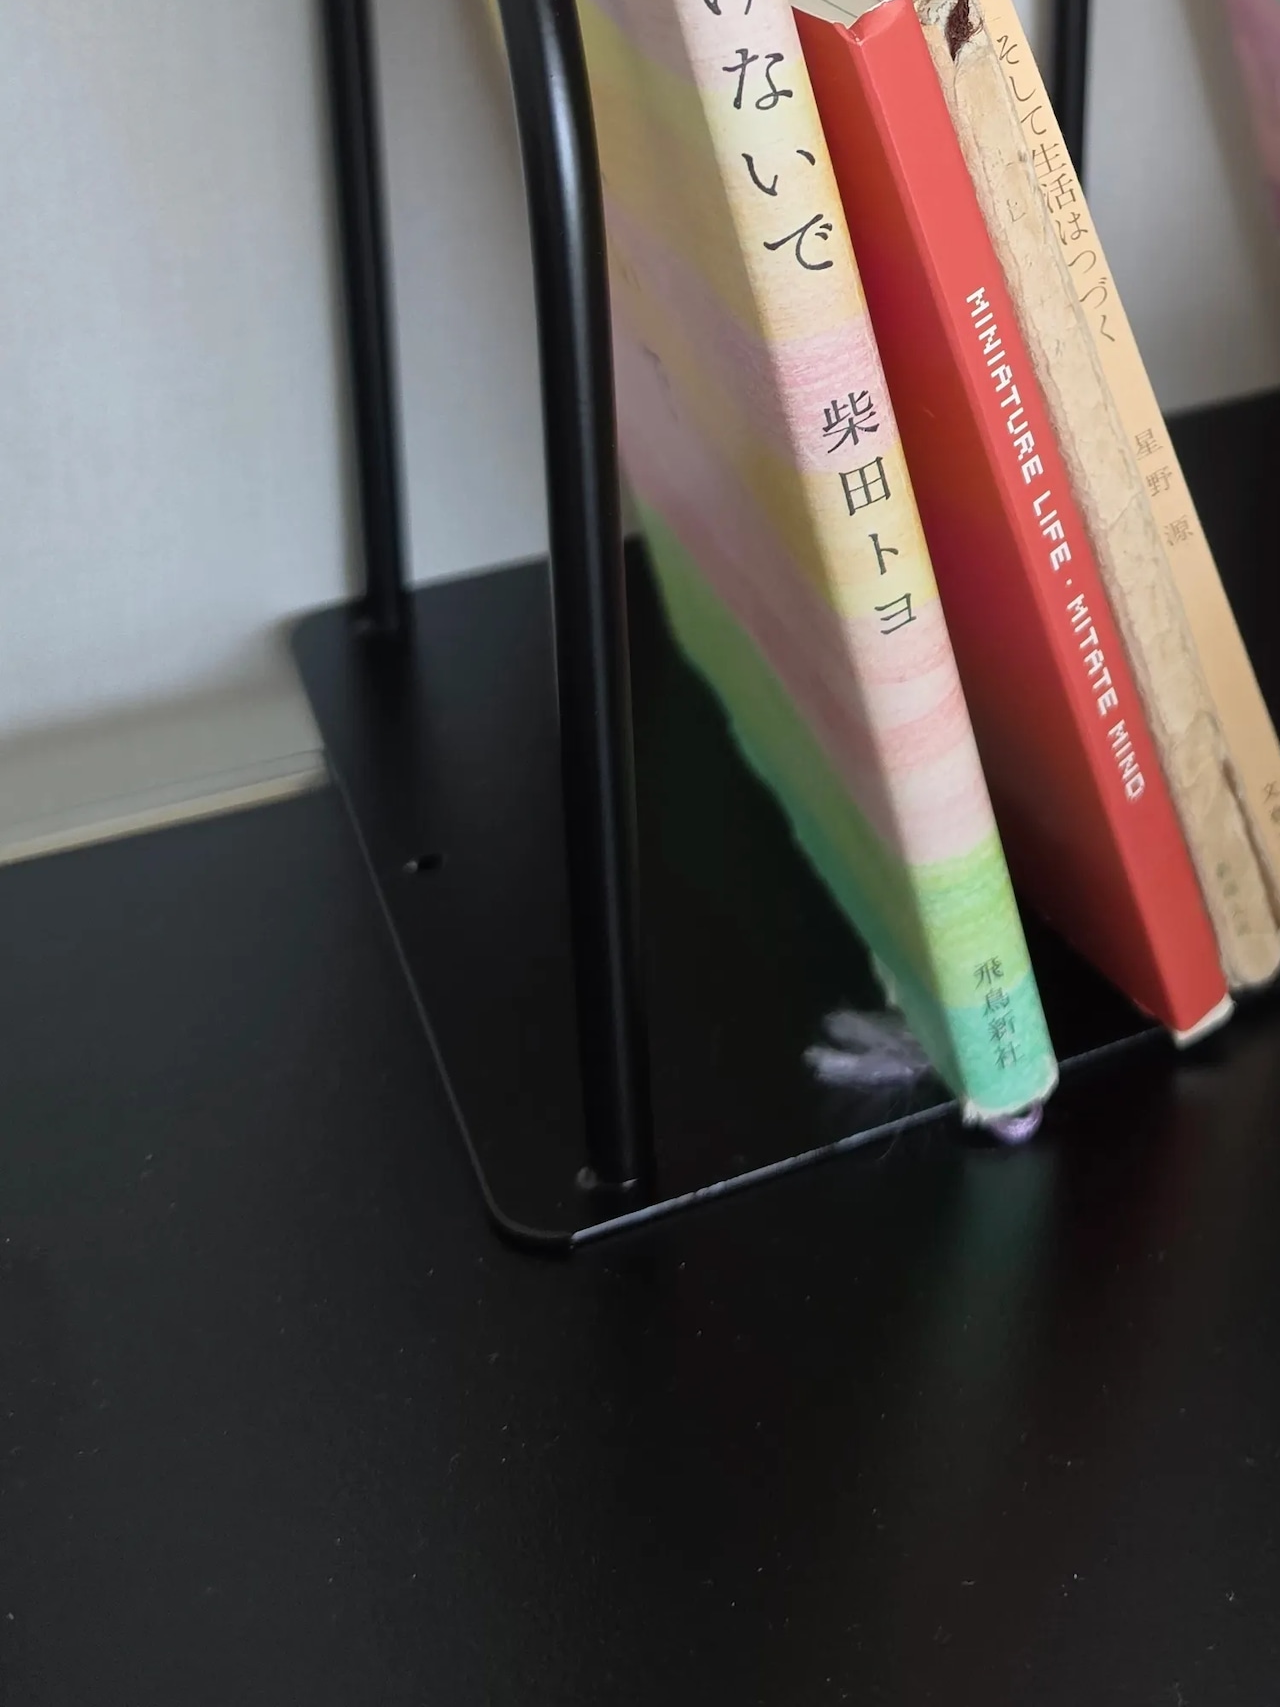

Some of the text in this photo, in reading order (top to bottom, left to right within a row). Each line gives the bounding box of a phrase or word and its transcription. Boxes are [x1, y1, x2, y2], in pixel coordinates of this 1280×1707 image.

[995, 34, 1116, 343] そして生活はつづく
[821, 389, 918, 636] 柴田トヨ
[965, 286, 1045, 485] MINIATURE
[1032, 489, 1073, 572] LIFE
[1065, 592, 1119, 716] MITATE
[1107, 718, 1146, 802] MIND
[973, 955, 1025, 1071] 飛鳥新社
